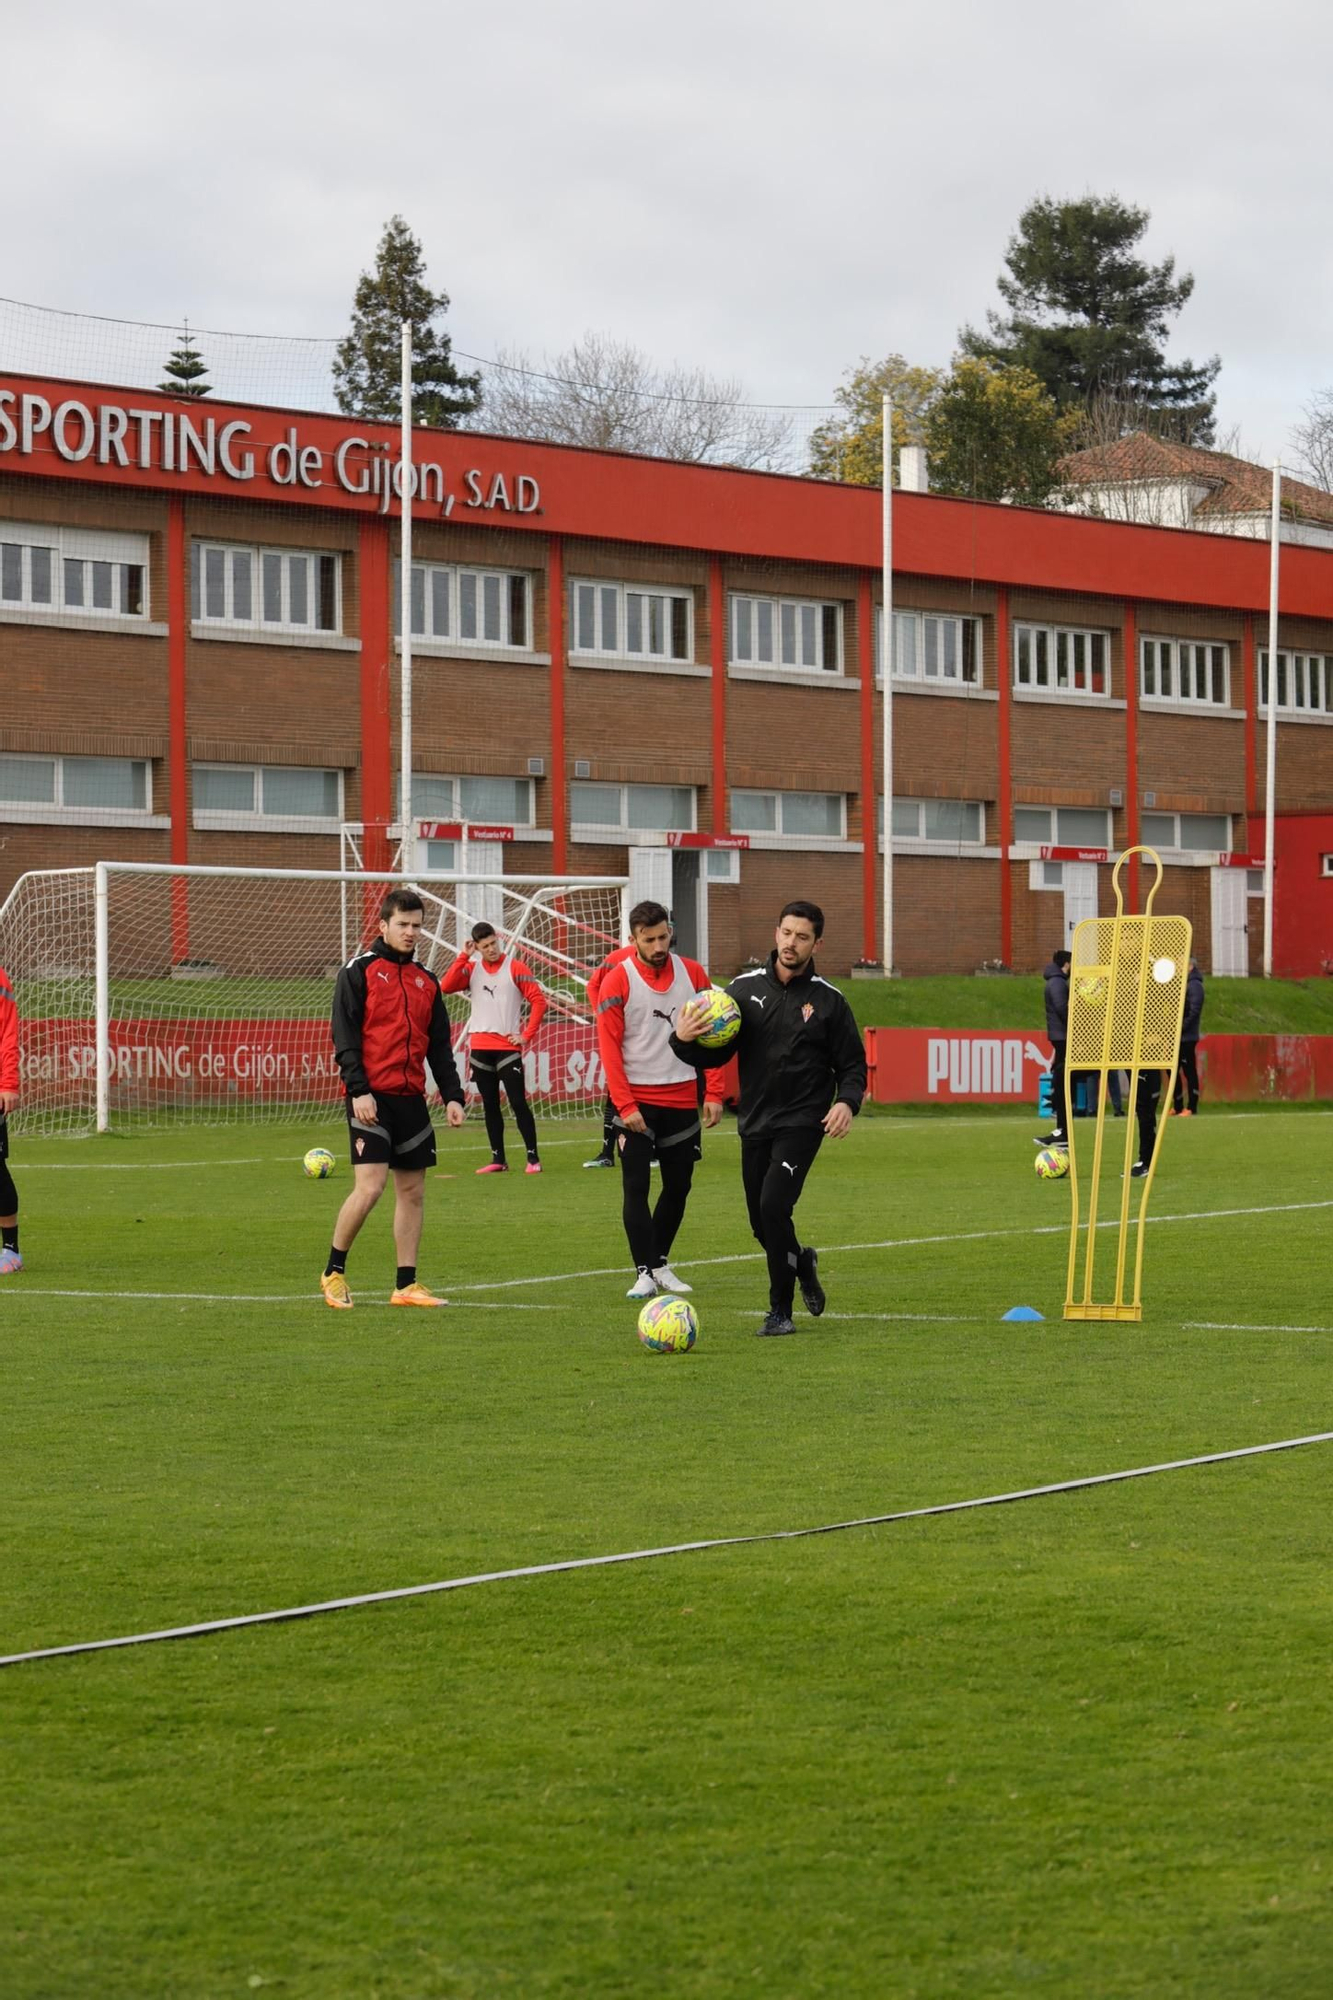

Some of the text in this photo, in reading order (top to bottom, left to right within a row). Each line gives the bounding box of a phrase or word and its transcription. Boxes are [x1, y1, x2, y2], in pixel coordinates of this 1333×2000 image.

[0, 389, 255, 480] SPORTING
[267, 427, 323, 488] de
[199, 1043, 226, 1078] de
[233, 1043, 296, 1088] Gijón,
[927, 1038, 1023, 1094] PUMA
